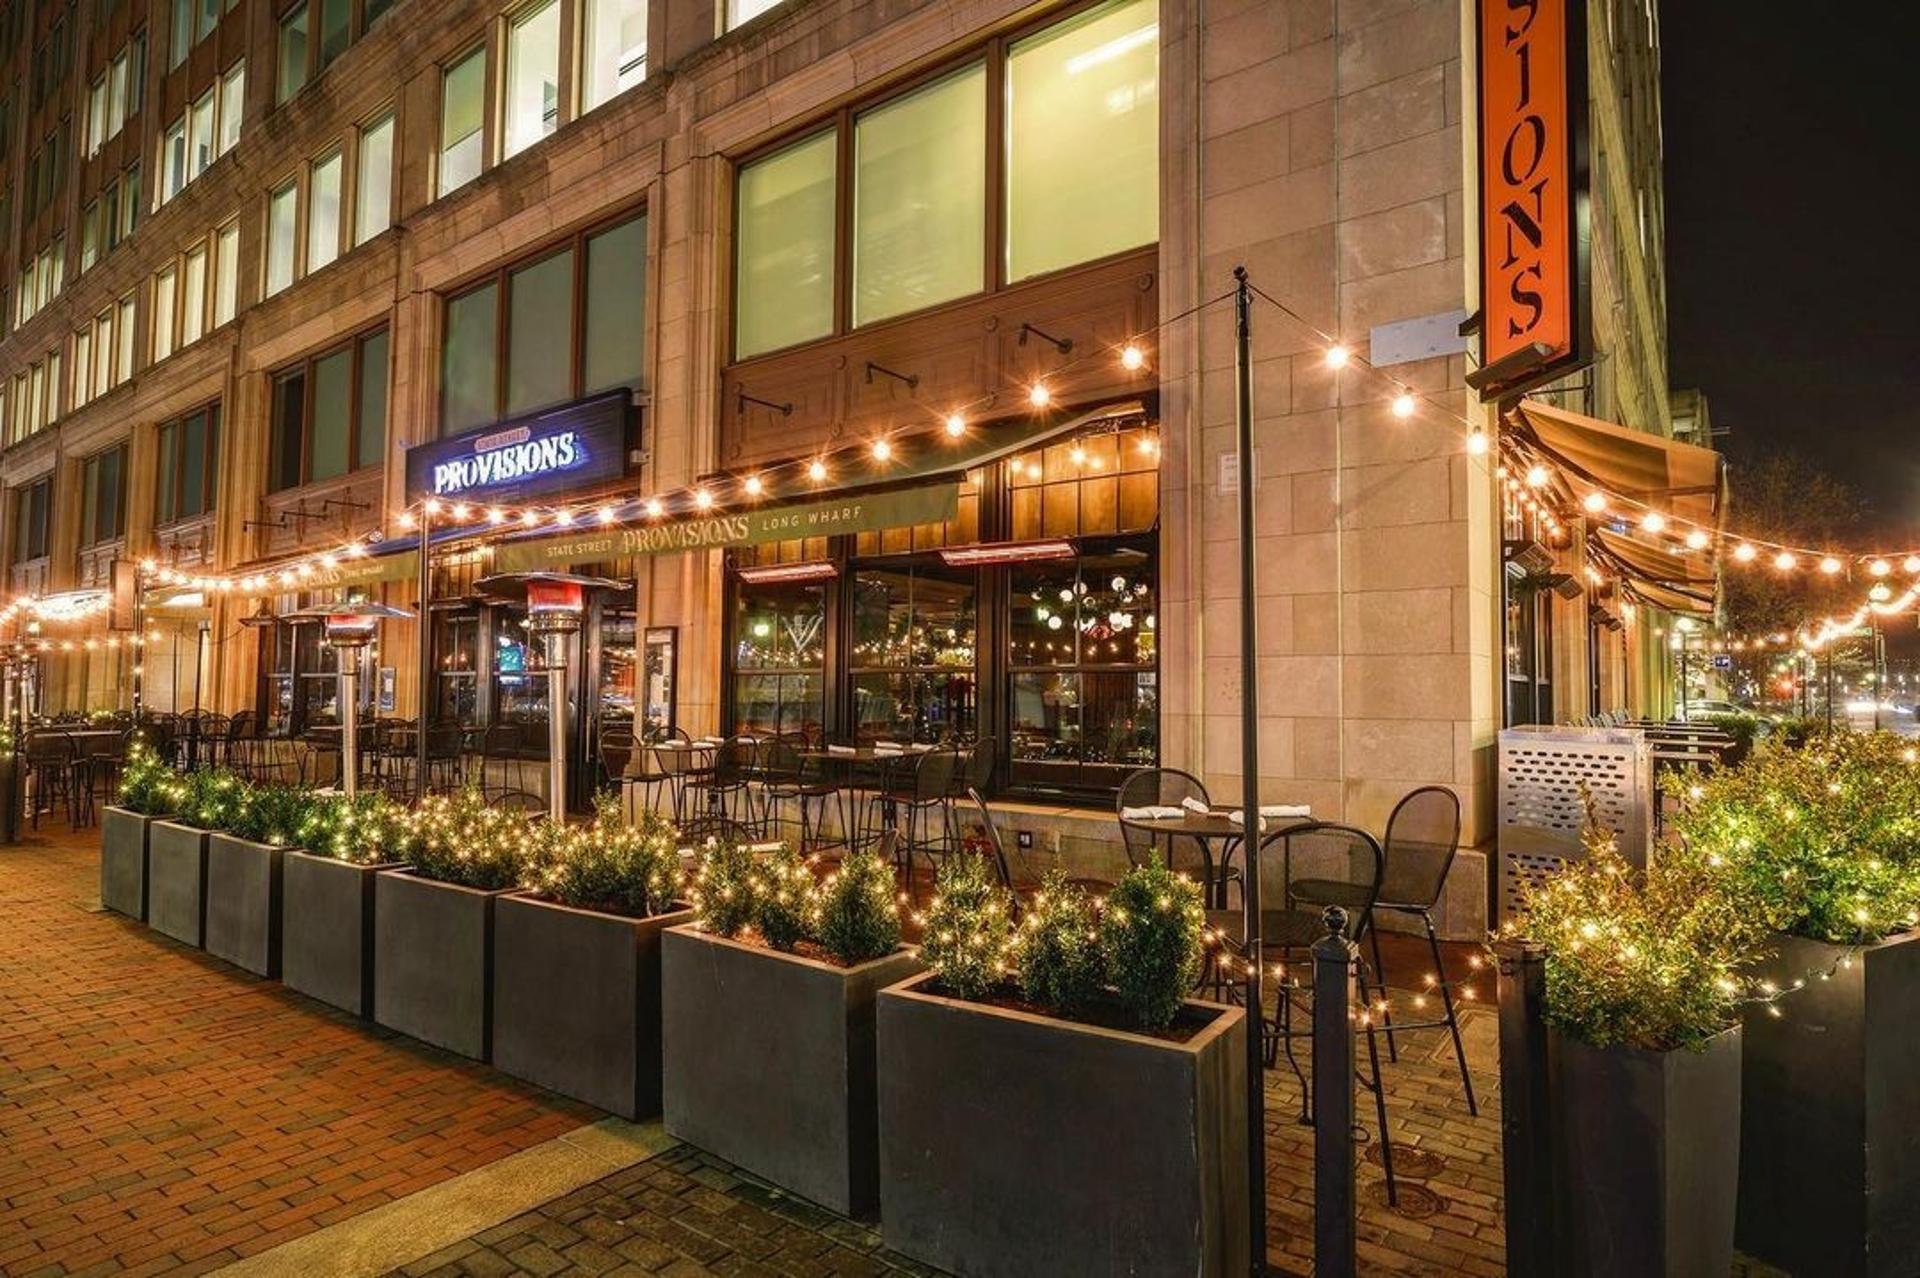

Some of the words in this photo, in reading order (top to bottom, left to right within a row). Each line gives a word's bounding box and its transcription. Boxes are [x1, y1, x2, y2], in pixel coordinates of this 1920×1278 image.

[434, 432, 574, 494] PROVISIONS
[546, 544, 573, 558] STATE
[576, 539, 612, 554] STREET
[623, 516, 749, 553] PROVISIONS
[762, 514, 799, 531] LONG
[808, 506, 861, 524] WHARF
